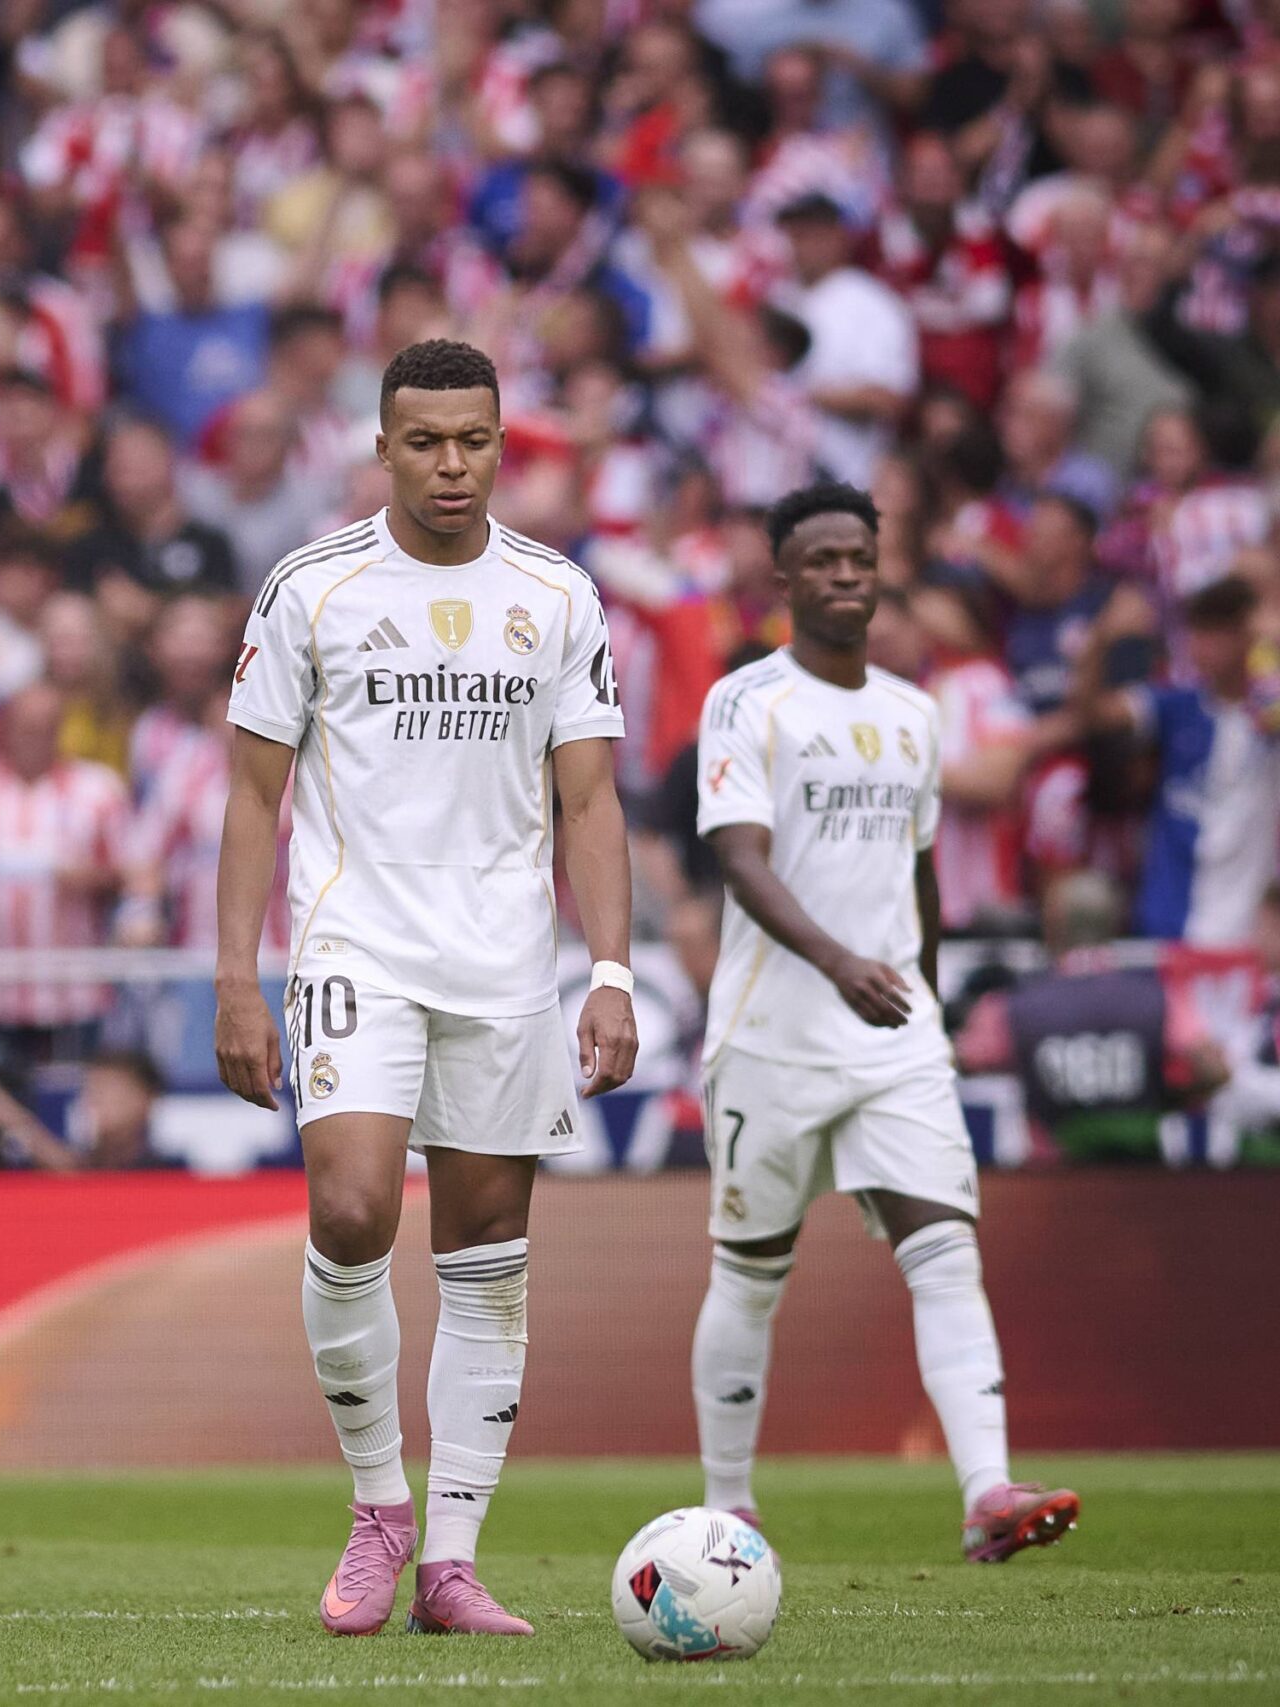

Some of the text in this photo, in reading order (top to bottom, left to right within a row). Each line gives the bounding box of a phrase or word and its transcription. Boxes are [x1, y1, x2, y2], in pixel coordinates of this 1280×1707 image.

[364, 664, 538, 705] Emirates
[393, 711, 510, 740] FLY BETTER
[819, 815, 850, 841] FLY
[303, 975, 357, 1048] 10
[724, 1109, 745, 1170] 7
